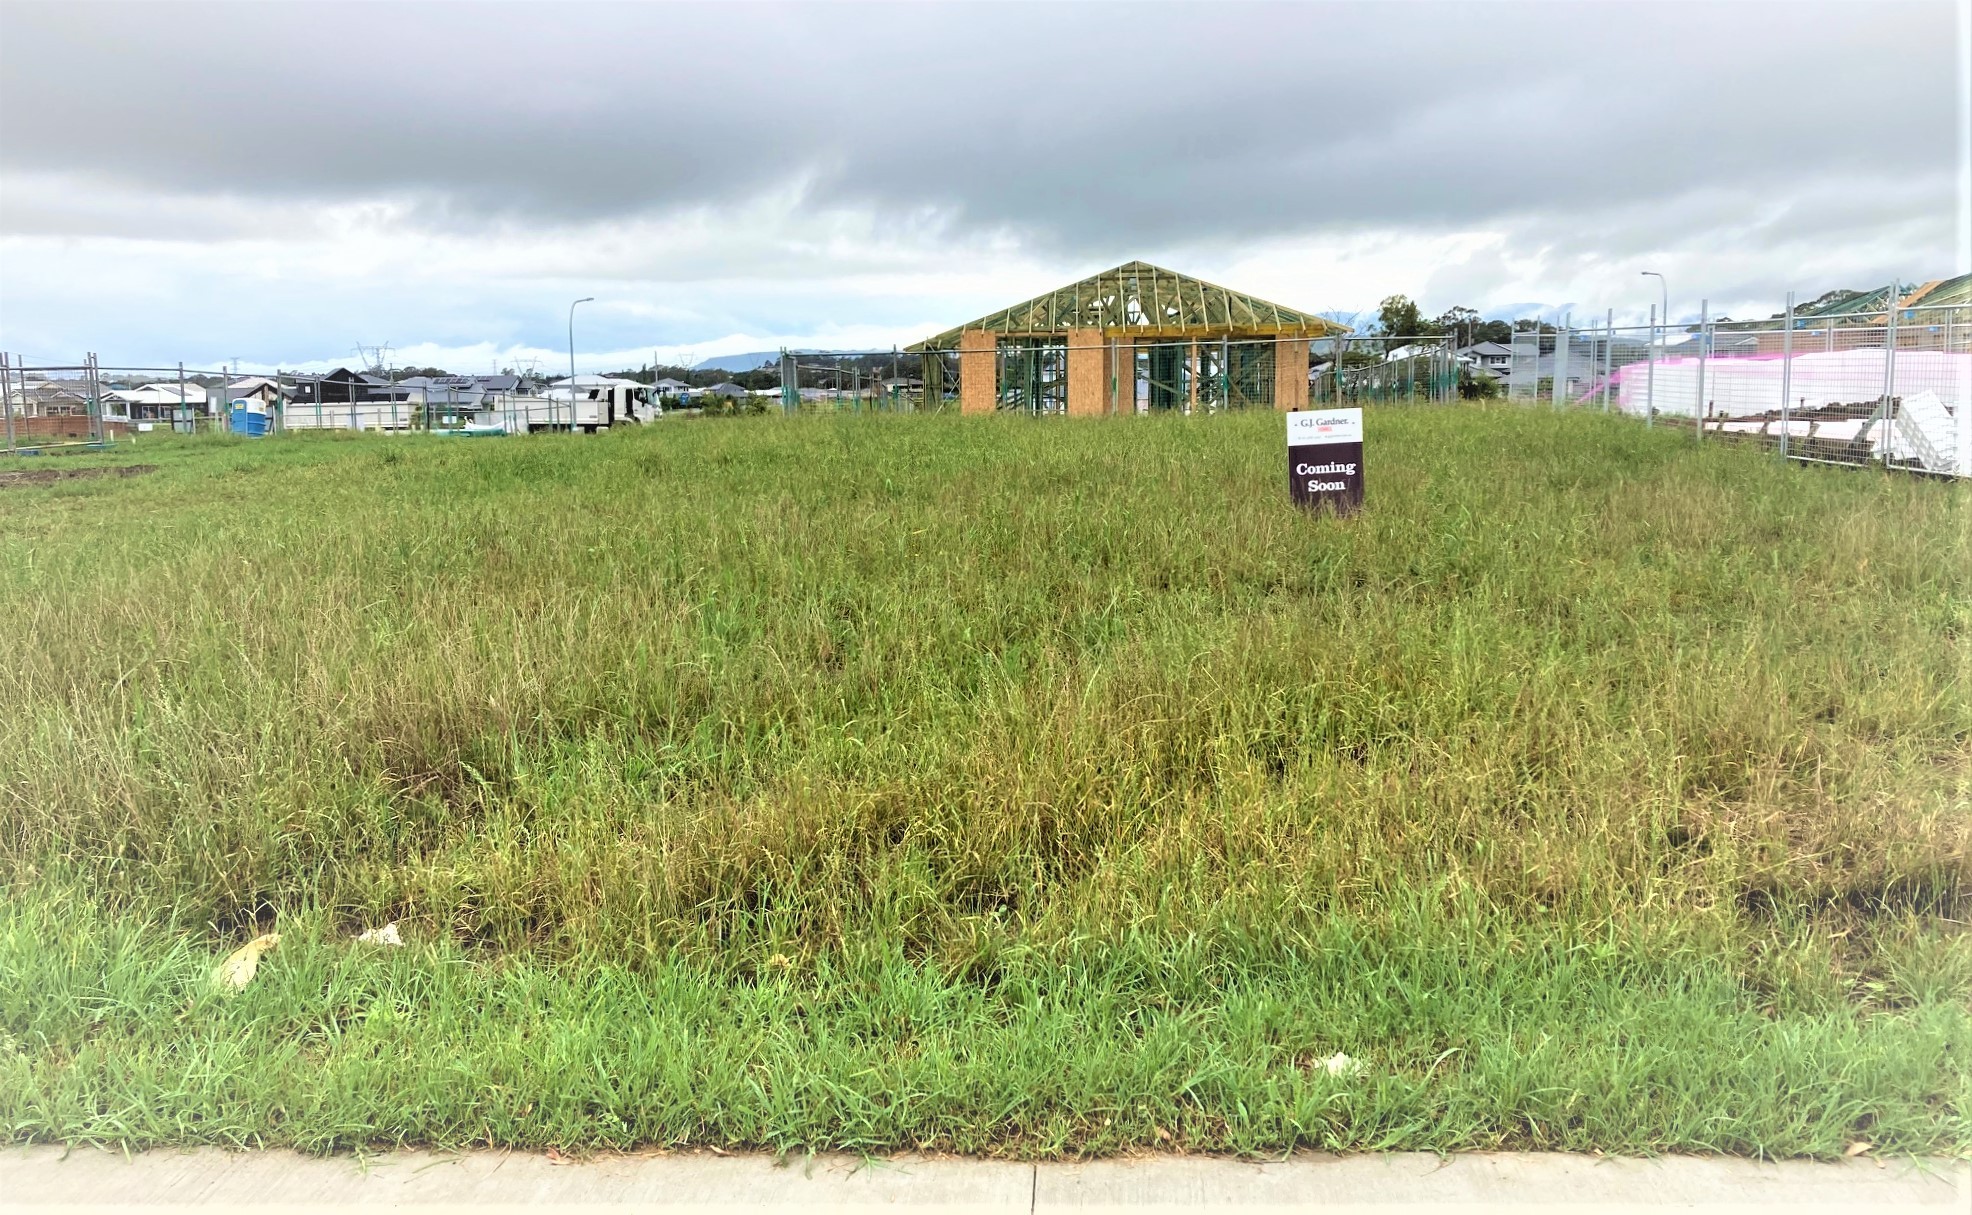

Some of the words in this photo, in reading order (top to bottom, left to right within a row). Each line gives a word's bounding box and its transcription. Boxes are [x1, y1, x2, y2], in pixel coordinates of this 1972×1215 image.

[1300, 419, 1315, 428] G.J.
[1296, 461, 1357, 475] Coming
[1308, 480, 1346, 492] Soon
